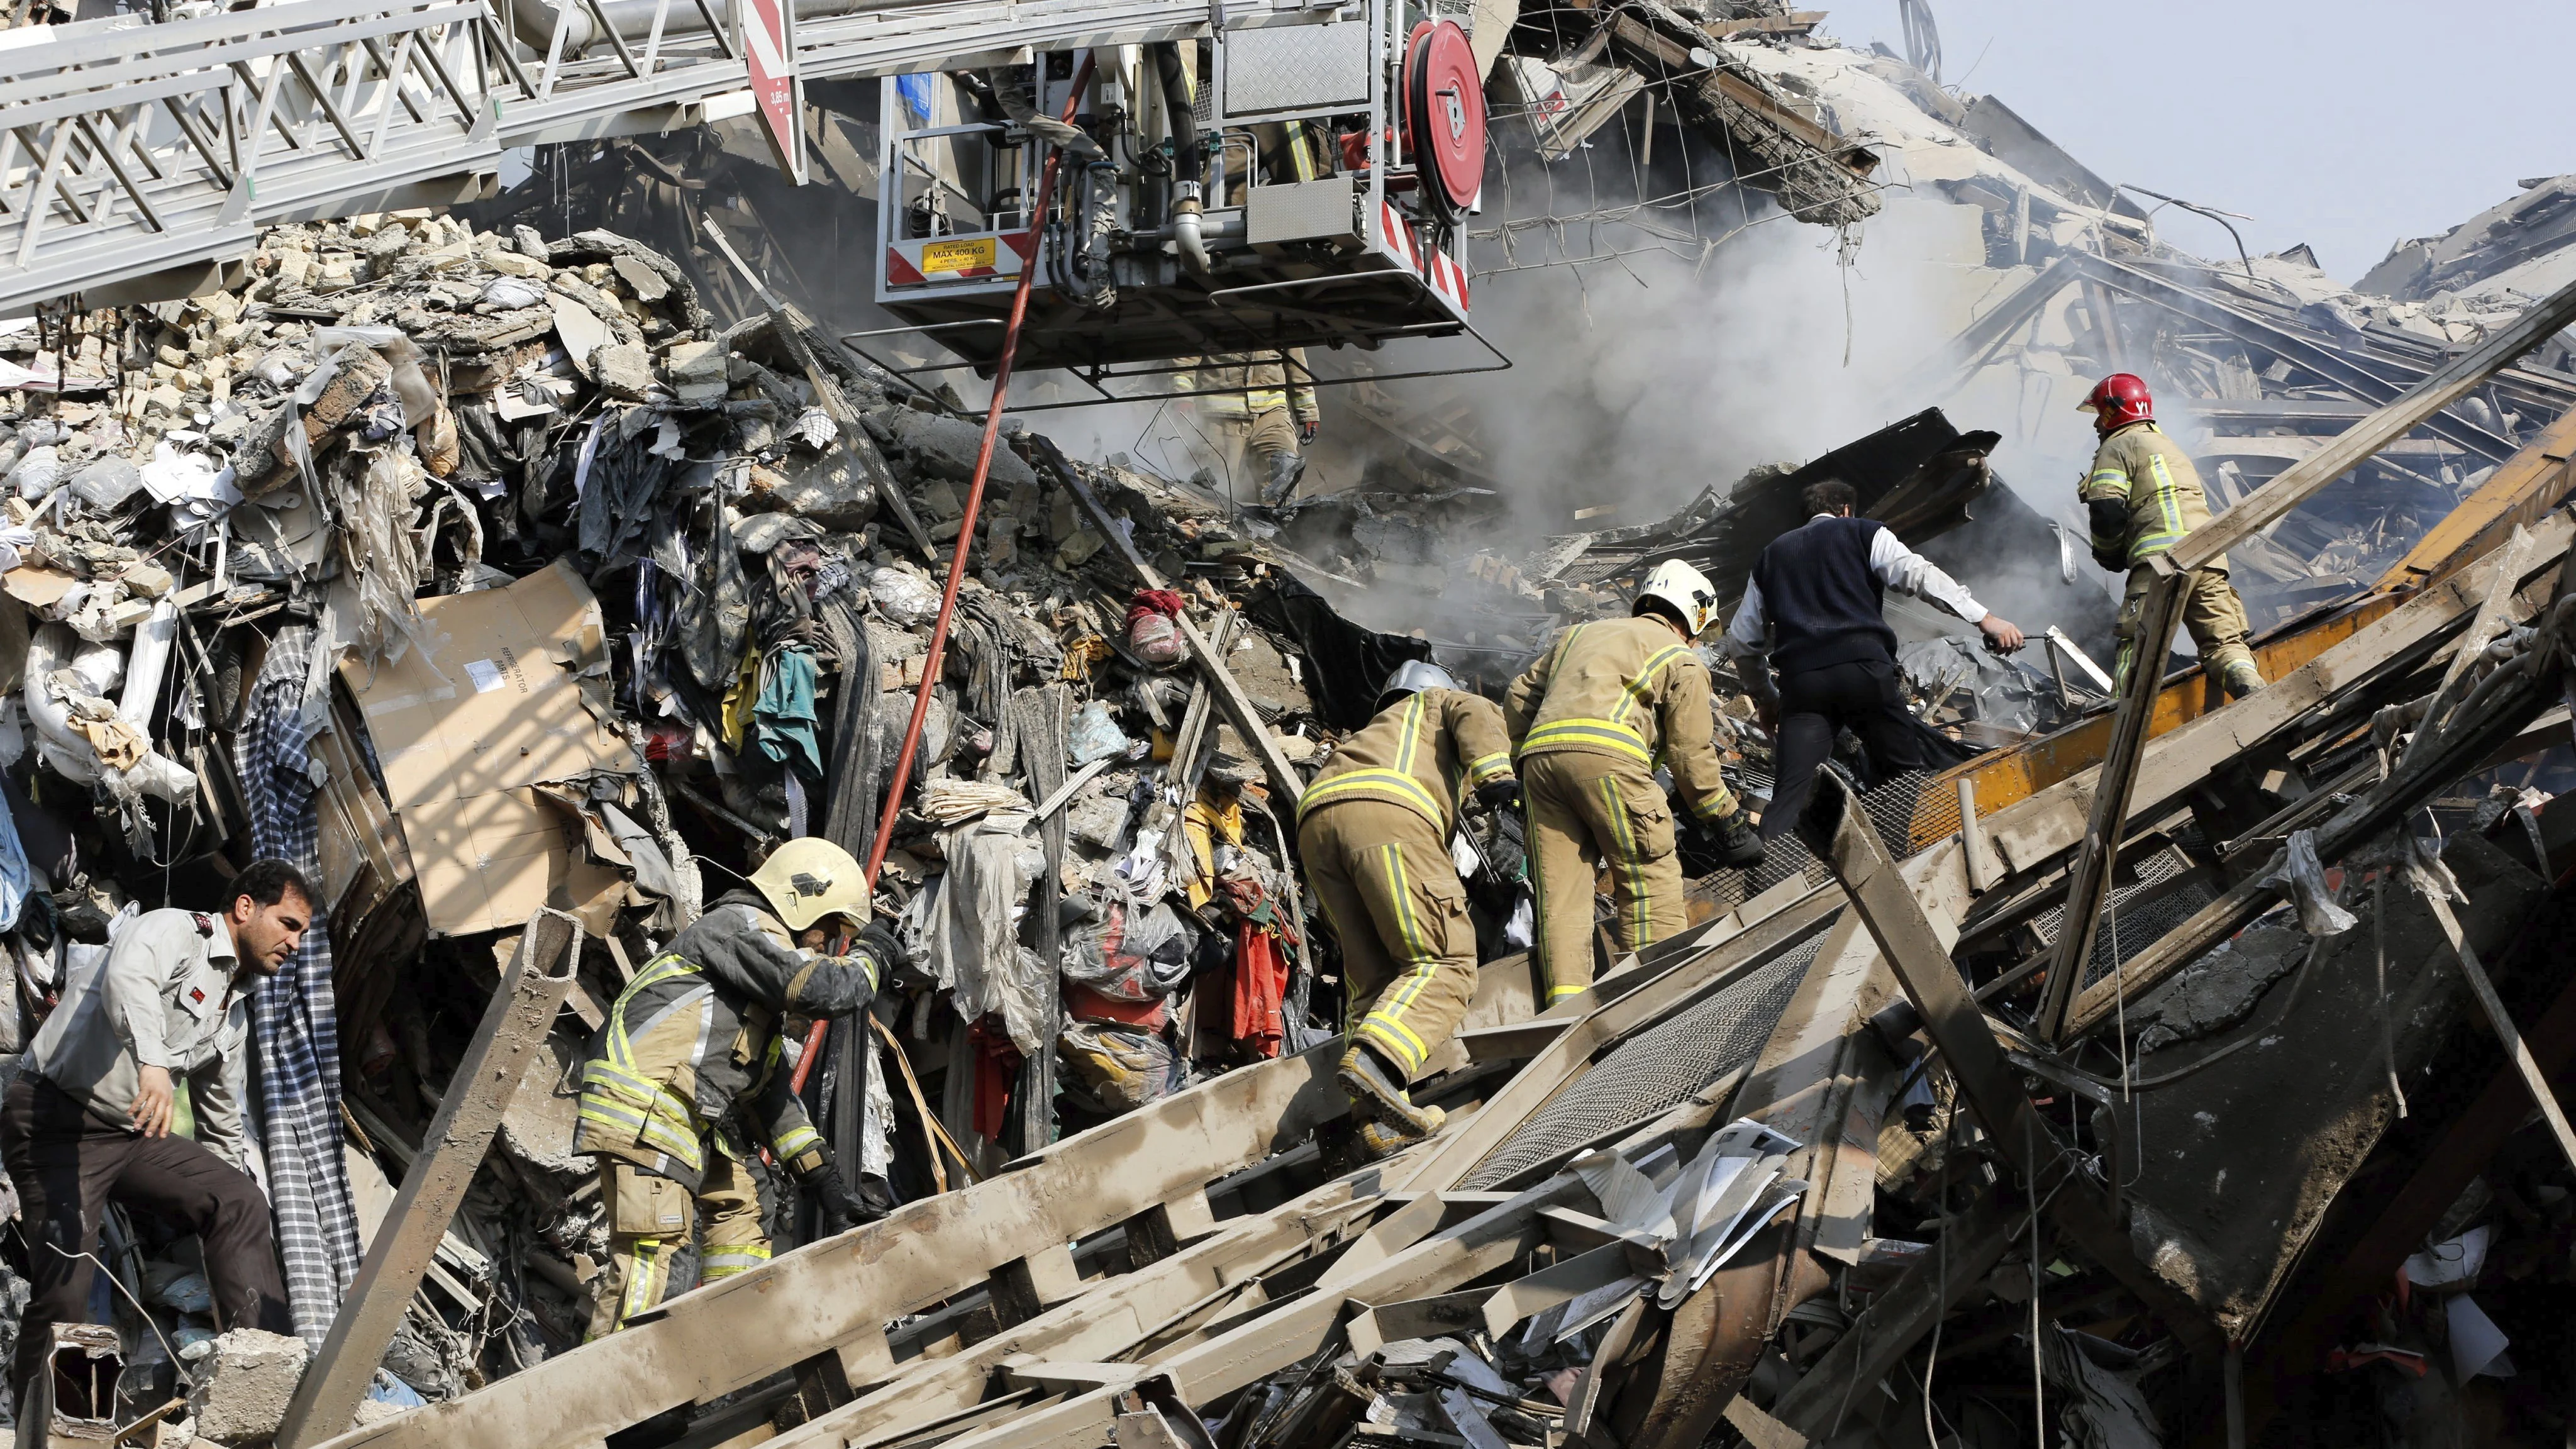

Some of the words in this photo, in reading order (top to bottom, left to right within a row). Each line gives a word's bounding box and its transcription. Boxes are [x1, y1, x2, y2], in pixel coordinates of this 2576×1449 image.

[770, 91, 782, 106] 3,85
[783, 93, 789, 103] m
[933, 250, 952, 258] MAX
[972, 247, 984, 255] KG
[495, 660, 511, 680] PARTS
[501, 647, 528, 694] REFRIGERATOR
